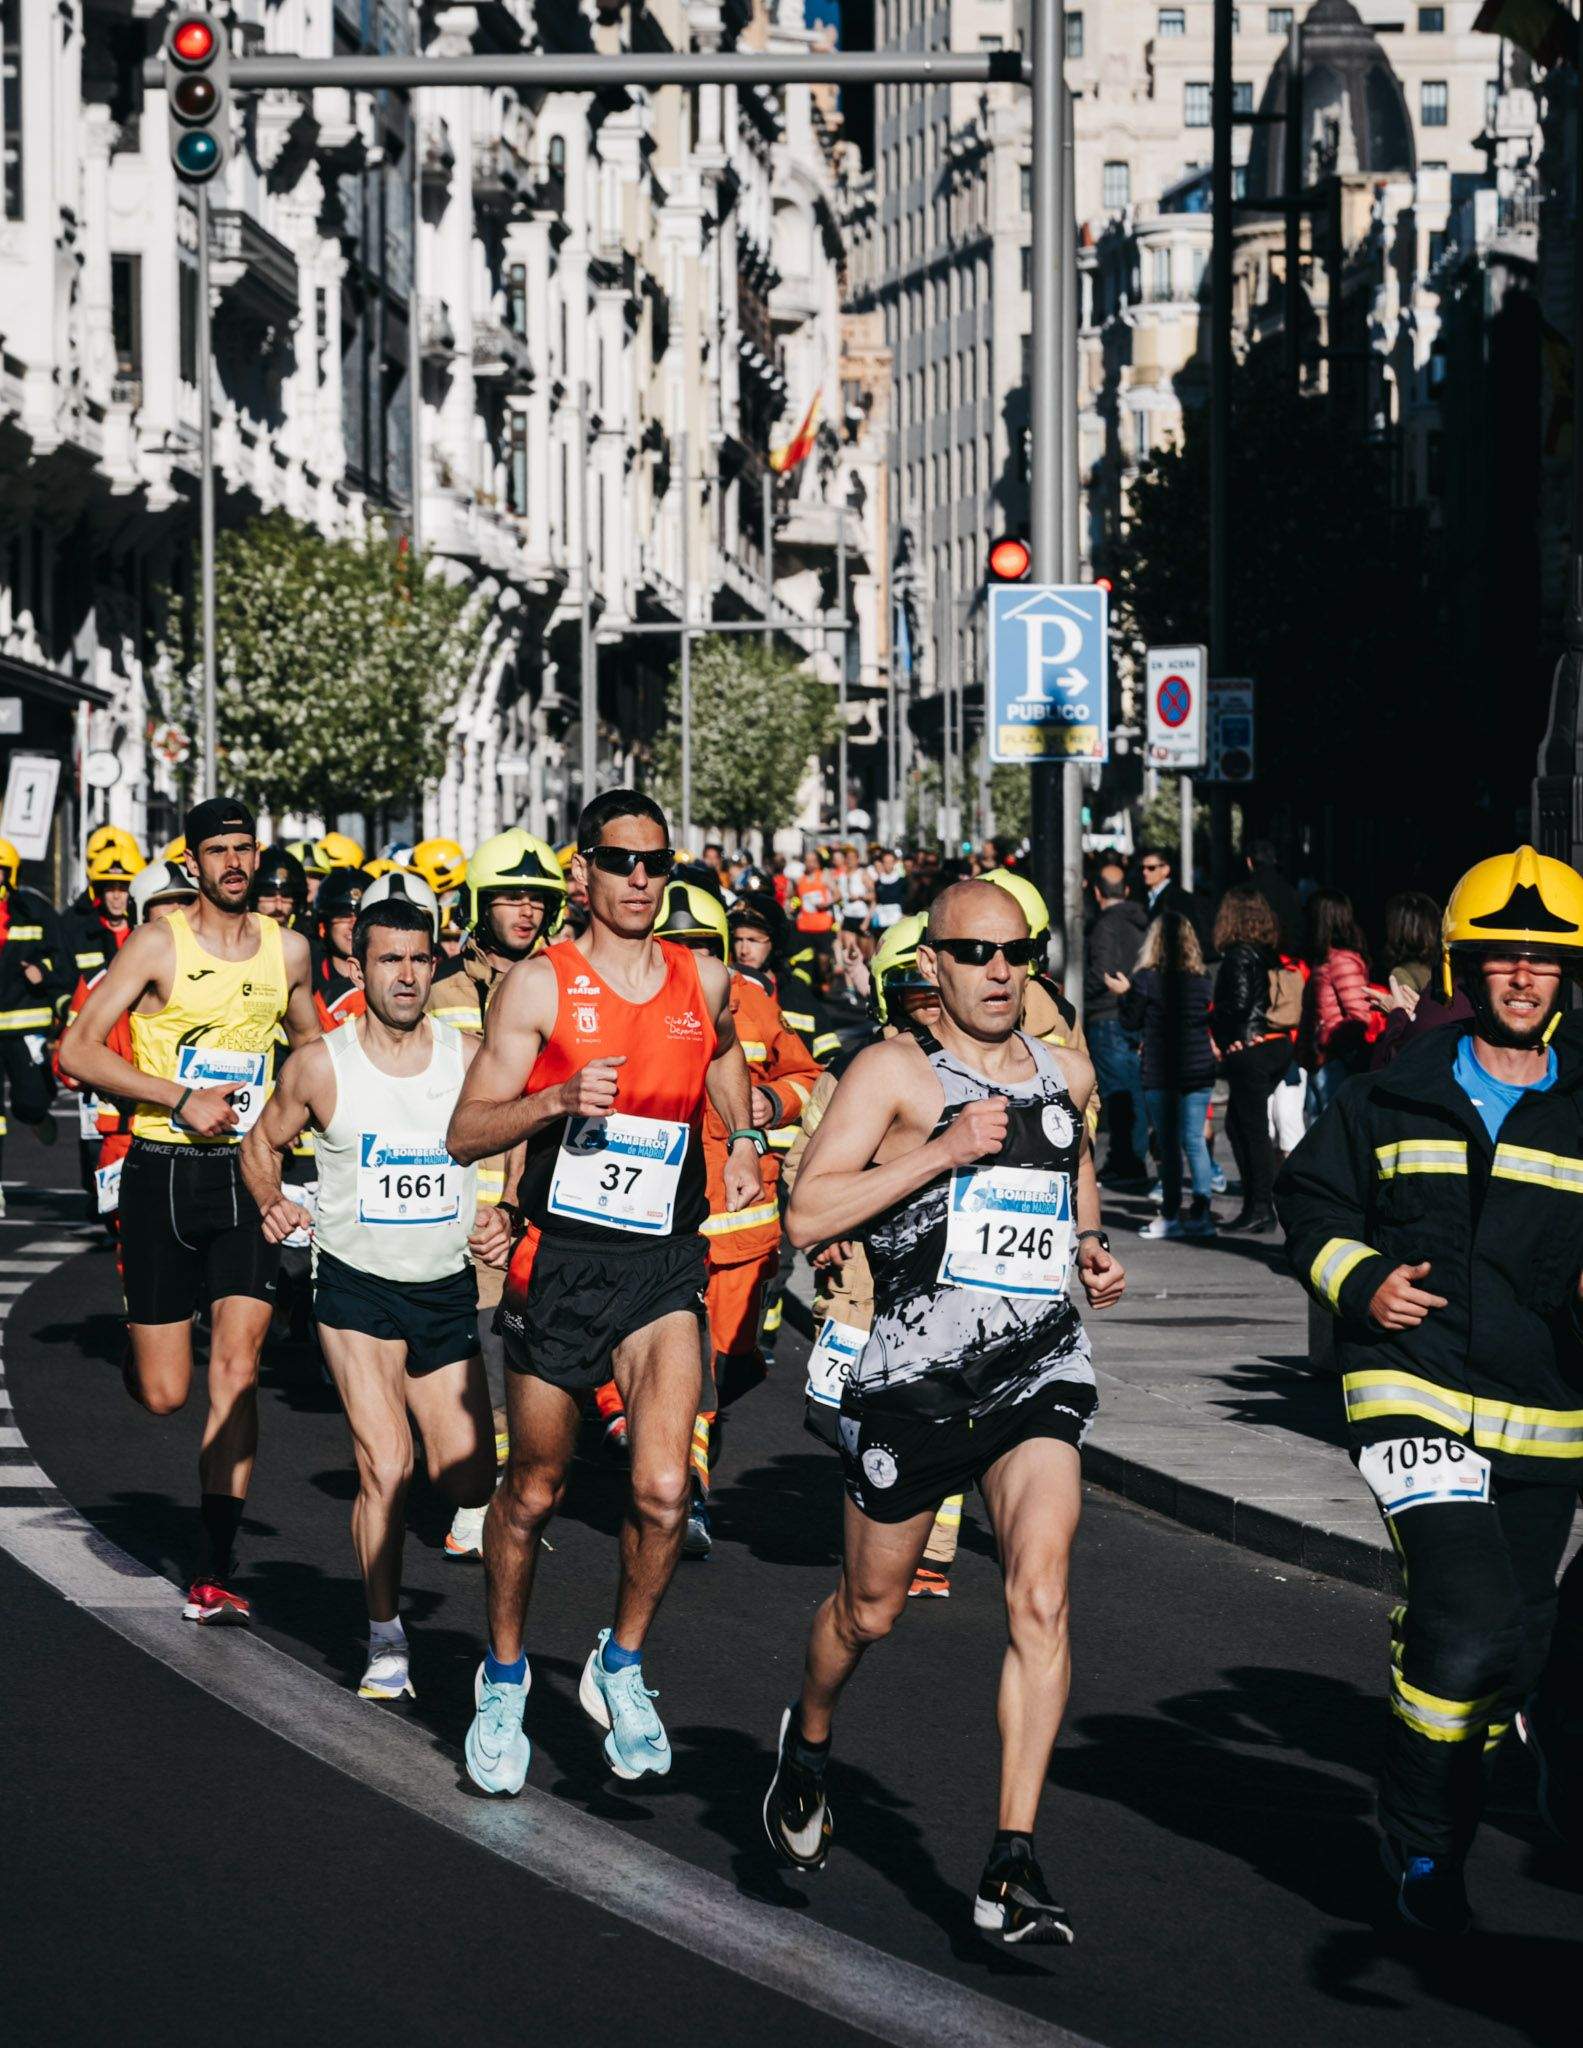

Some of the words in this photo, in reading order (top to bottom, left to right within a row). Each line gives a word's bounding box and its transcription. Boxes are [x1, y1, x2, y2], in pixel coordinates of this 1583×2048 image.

[1015, 613, 1084, 703] P
[140, 1143, 172, 1155] NIKE
[605, 1131, 667, 1150] BOMBEROS
[393, 1148, 448, 1157] BOMBEROS
[379, 1173, 446, 1199] 1661
[600, 1163, 643, 1194] 37
[995, 1188, 1057, 1204] BOMBEROS
[1021, 1202, 1031, 1212] de
[976, 1222, 1054, 1260] 1246
[1383, 1437, 1466, 1474] 1056
